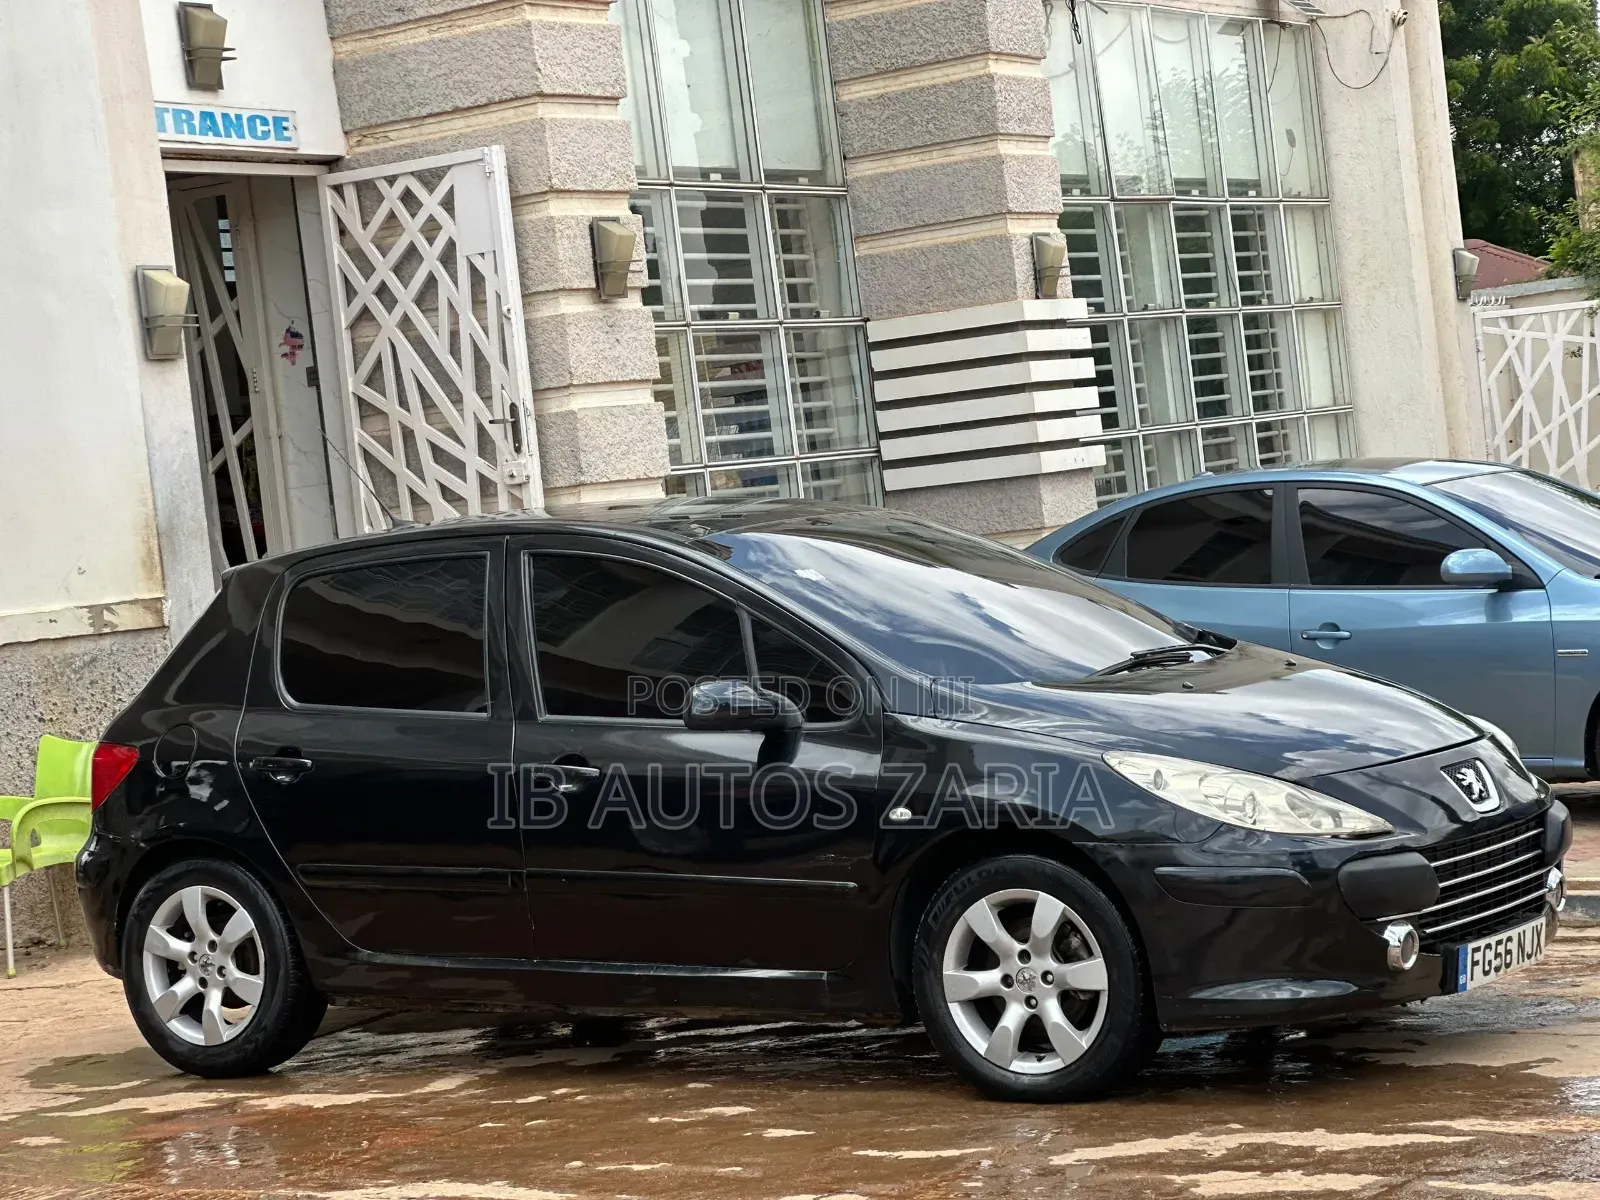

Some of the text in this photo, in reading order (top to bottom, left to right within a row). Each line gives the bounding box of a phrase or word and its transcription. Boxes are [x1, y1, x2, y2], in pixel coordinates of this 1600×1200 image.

[154, 106, 292, 141] TRANCE
[1470, 923, 1543, 981] FG56 NJX
